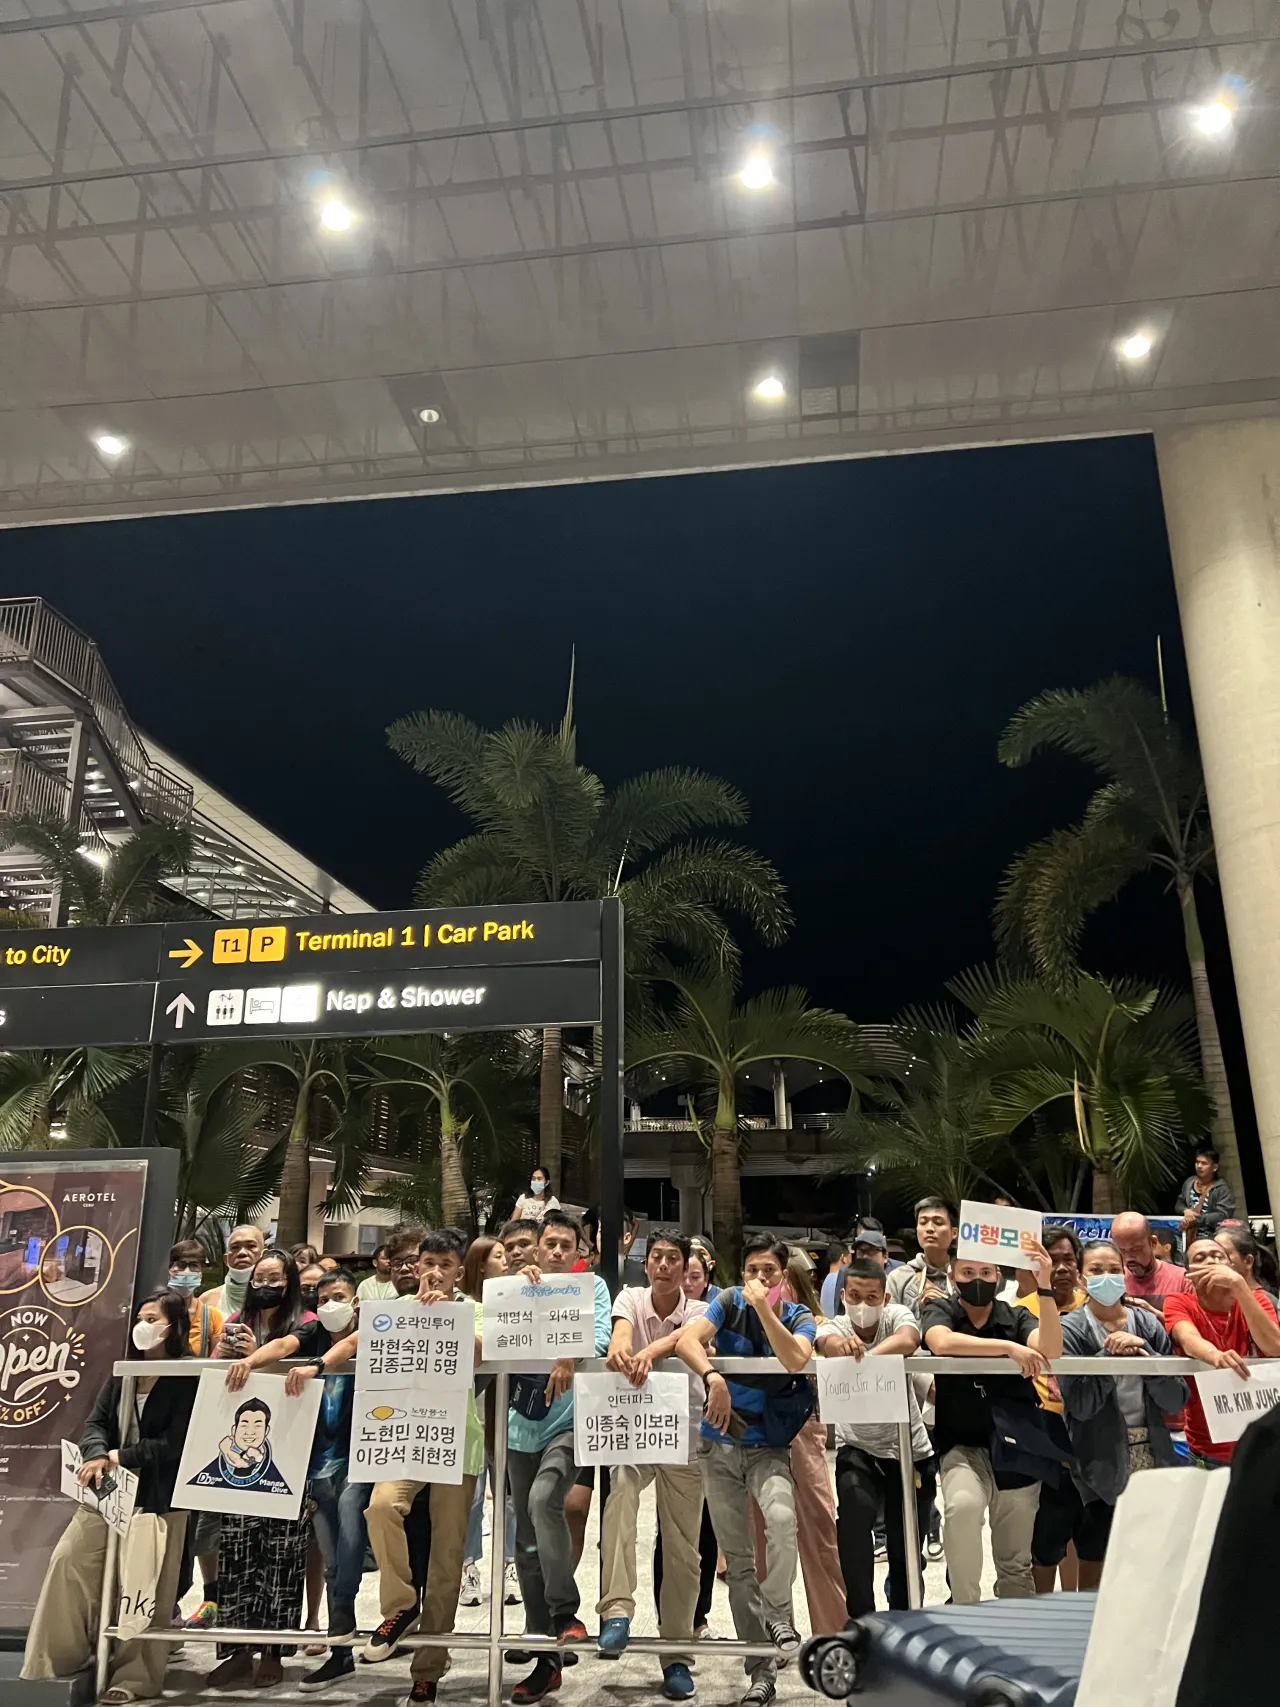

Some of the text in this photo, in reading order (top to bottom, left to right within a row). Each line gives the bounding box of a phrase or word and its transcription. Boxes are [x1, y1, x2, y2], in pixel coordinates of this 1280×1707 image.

[221, 939, 241, 953] T1
[260, 936, 274, 952] P
[296, 927, 393, 951] Terminal
[401, 926, 414, 946] 1
[437, 924, 476, 945] Car
[483, 920, 534, 942] Park
[6, 944, 71, 967] to City
[326, 985, 487, 1014] Nap & Shower
[62, 1192, 117, 1203] AEROTEL
[10, 1311, 49, 1327] NOW
[395, 1316, 455, 1331] 온라인투어
[549, 1308, 580, 1322] 외4명
[370, 1339, 459, 1357] 박현숙외 3명
[496, 1331, 584, 1348] 솔레아 리조트
[0, 1340, 80, 1402] pen
[369, 1357, 458, 1375] 김종근외 5명
[820, 1372, 896, 1402] Young Jin Kim
[607, 1393, 654, 1408] 인터파크
[1213, 1394, 1234, 1414] MR.
[1233, 1391, 1254, 1412] KIM
[586, 1413, 680, 1433] 이종숙 이보라
[360, 1423, 456, 1444] 노현민 외3명
[586, 1432, 680, 1451] 김가람 김아라
[356, 1446, 457, 1467] 이강석 최현정
